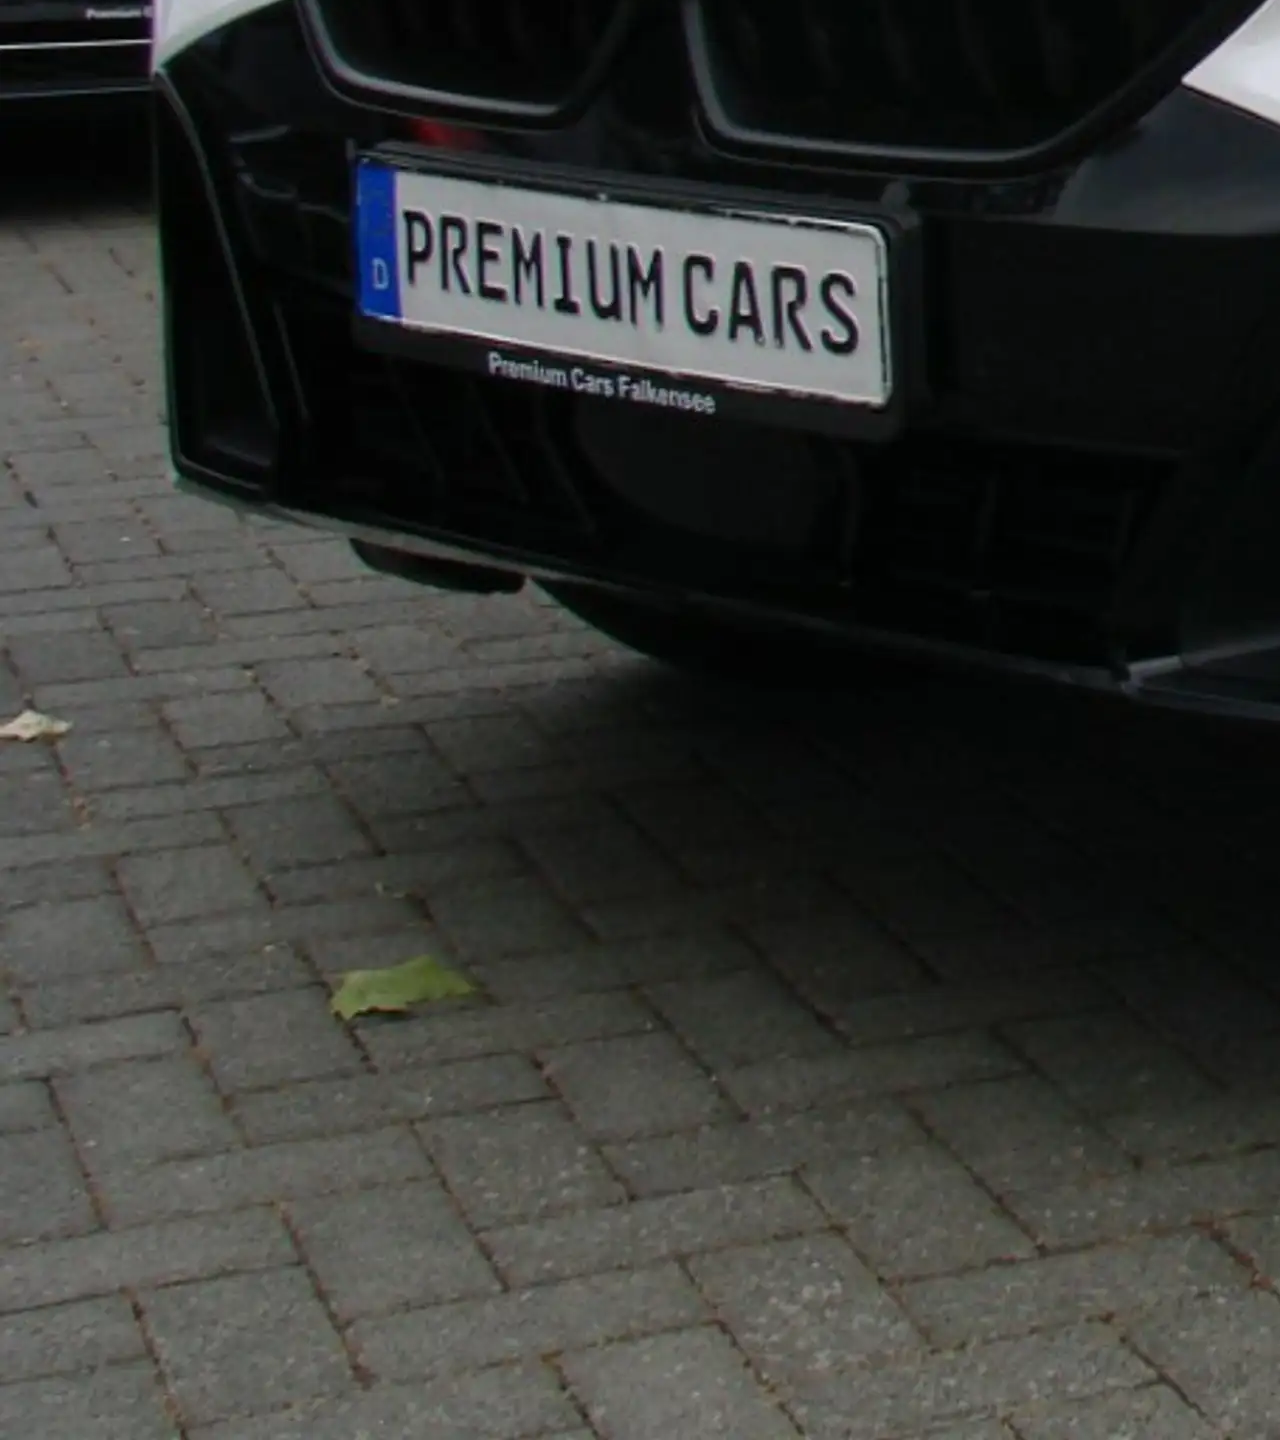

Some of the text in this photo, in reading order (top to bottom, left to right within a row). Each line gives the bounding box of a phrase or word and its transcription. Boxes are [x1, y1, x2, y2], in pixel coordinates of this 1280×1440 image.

[372, 257, 389, 290] D
[403, 210, 861, 355] PREMIUM CARS
[488, 350, 717, 414] Premium Cars Falkensee
